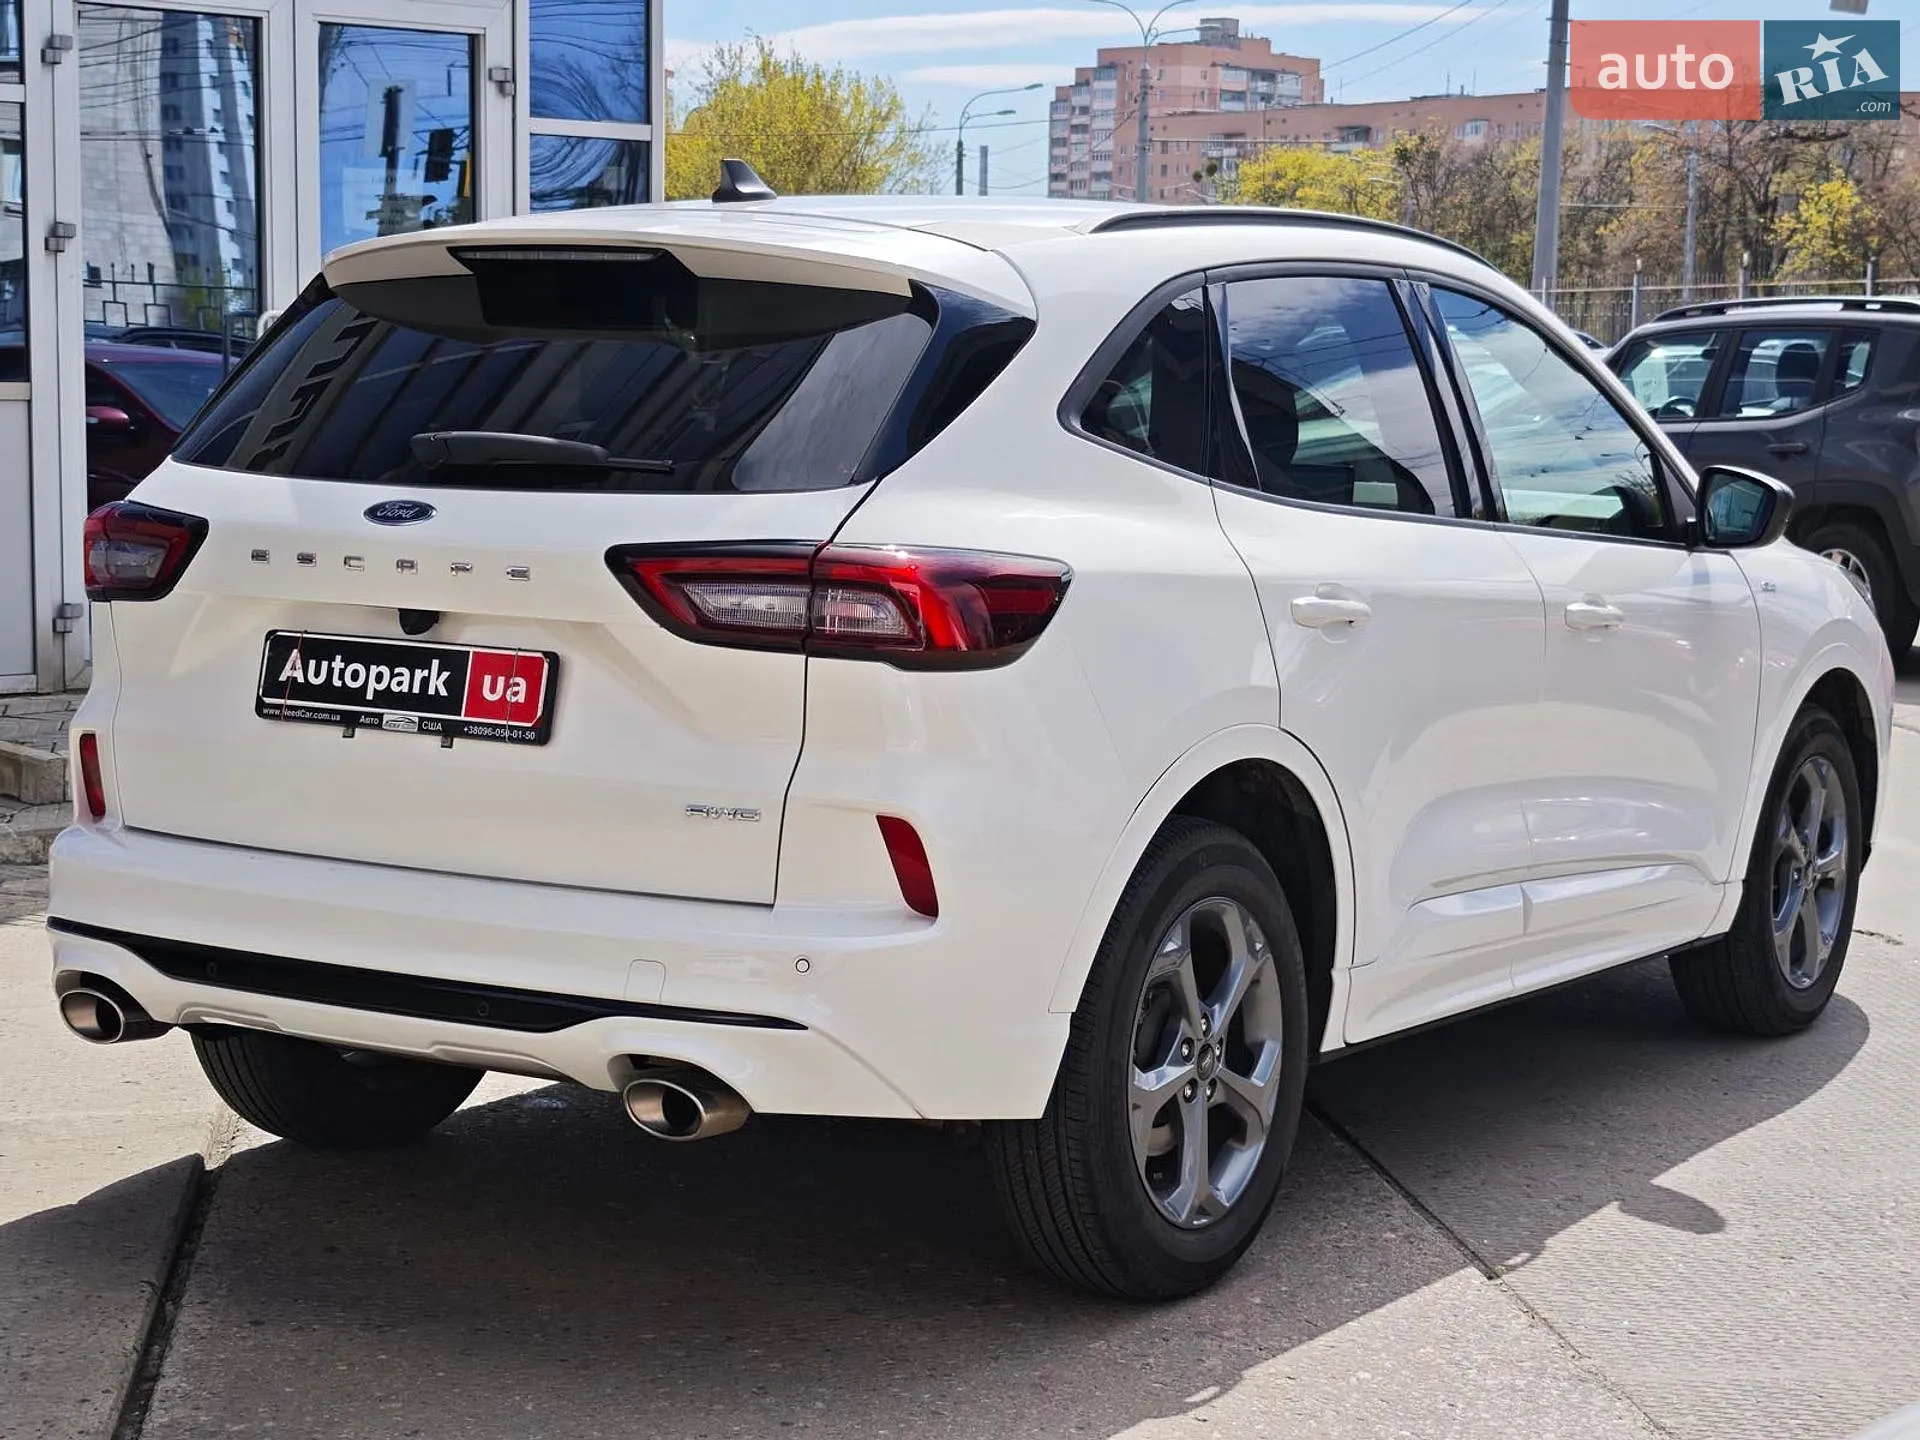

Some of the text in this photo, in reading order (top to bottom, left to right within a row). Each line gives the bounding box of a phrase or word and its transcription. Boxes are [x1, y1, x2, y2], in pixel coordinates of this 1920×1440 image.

[377, 502, 420, 518] Ford
[250, 549, 531, 581] ESCAPE
[279, 649, 527, 703] Autopark ua
